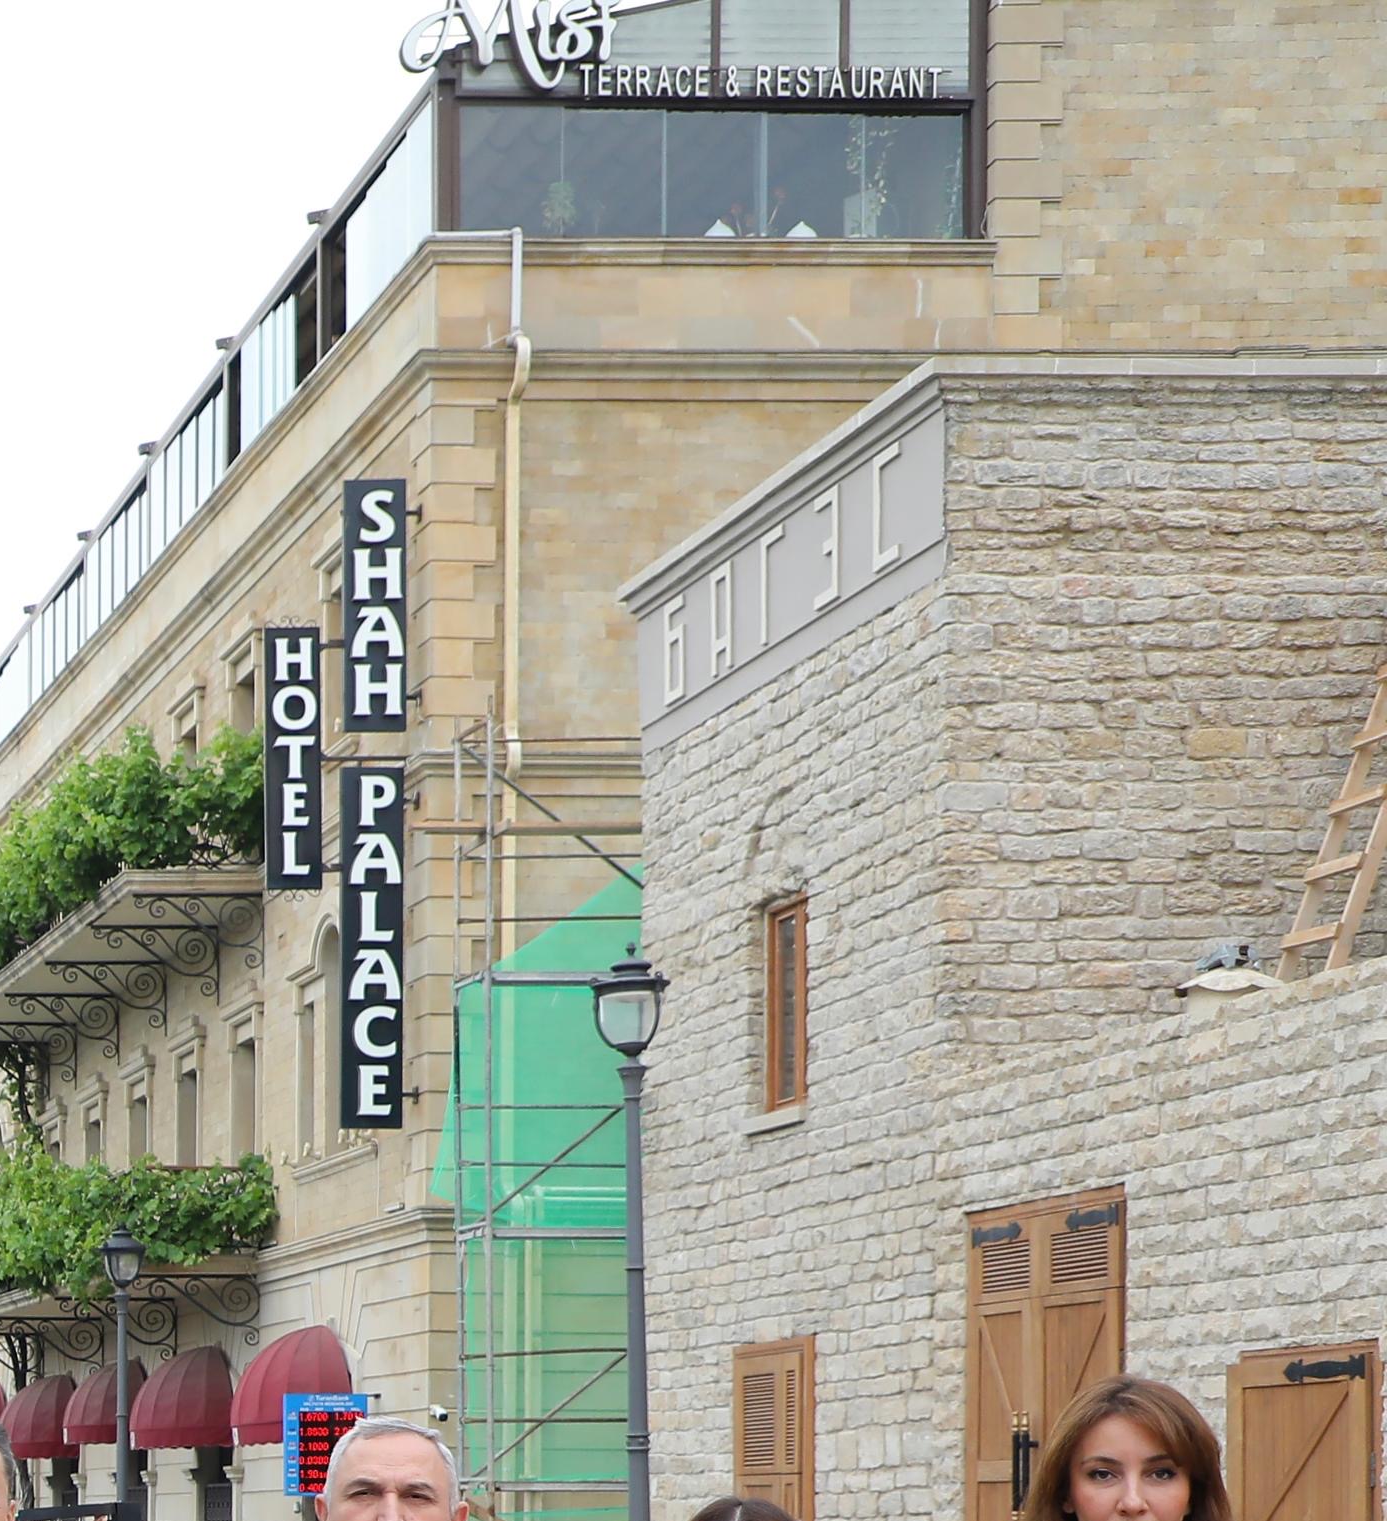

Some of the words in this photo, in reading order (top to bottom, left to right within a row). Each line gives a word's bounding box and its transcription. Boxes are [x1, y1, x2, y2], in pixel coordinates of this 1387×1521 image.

[579, 64, 710, 98] TERRACE
[726, 65, 742, 98] &
[756, 64, 943, 99] RESTAURANT
[351, 488, 404, 719] SHAH
[271, 636, 318, 877] HOTEL
[349, 774, 402, 1118] PALACE
